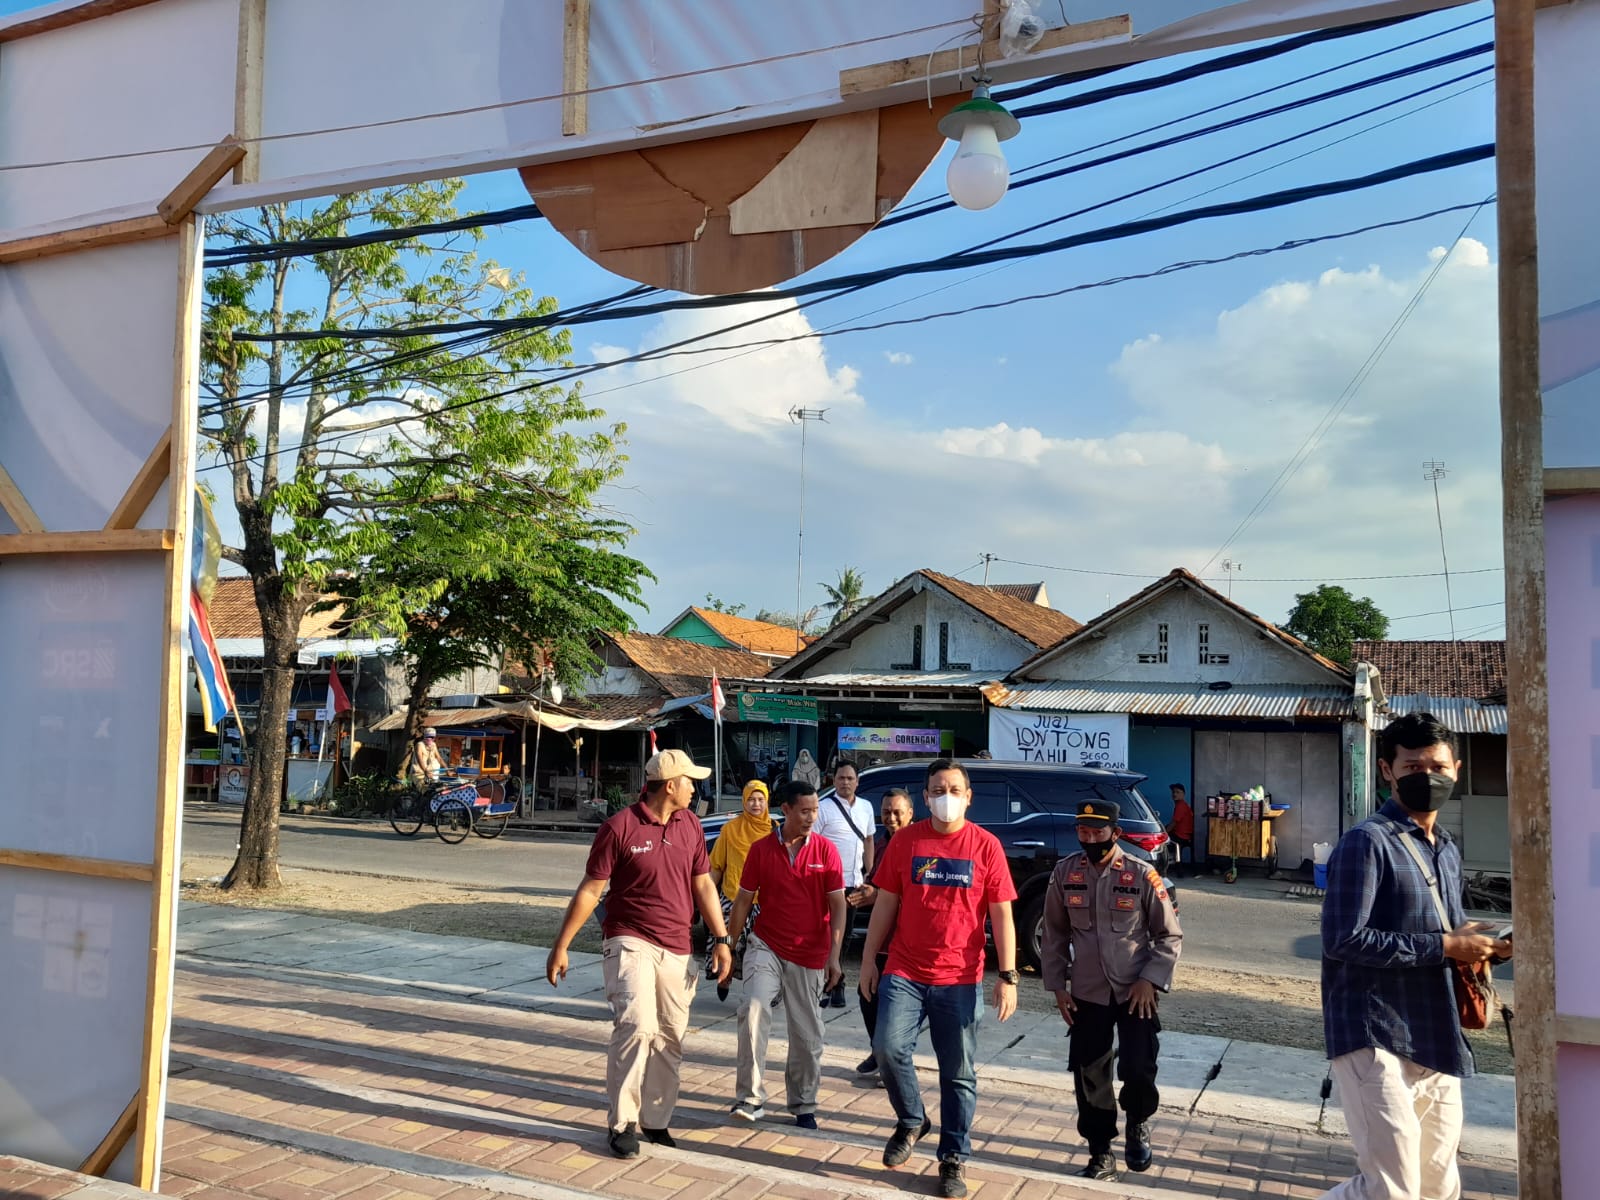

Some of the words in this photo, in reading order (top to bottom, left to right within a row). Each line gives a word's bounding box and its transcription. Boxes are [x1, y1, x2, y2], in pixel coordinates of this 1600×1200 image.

[870, 733, 891, 743] Rasa
[895, 734, 936, 745] GORENGAN
[1016, 727, 1111, 749] LONTONG
[1079, 751, 1110, 761] SEGO
[924, 870, 945, 879] Bank
[945, 872, 969, 883] Jateng
[1112, 885, 1140, 895] POLRI
